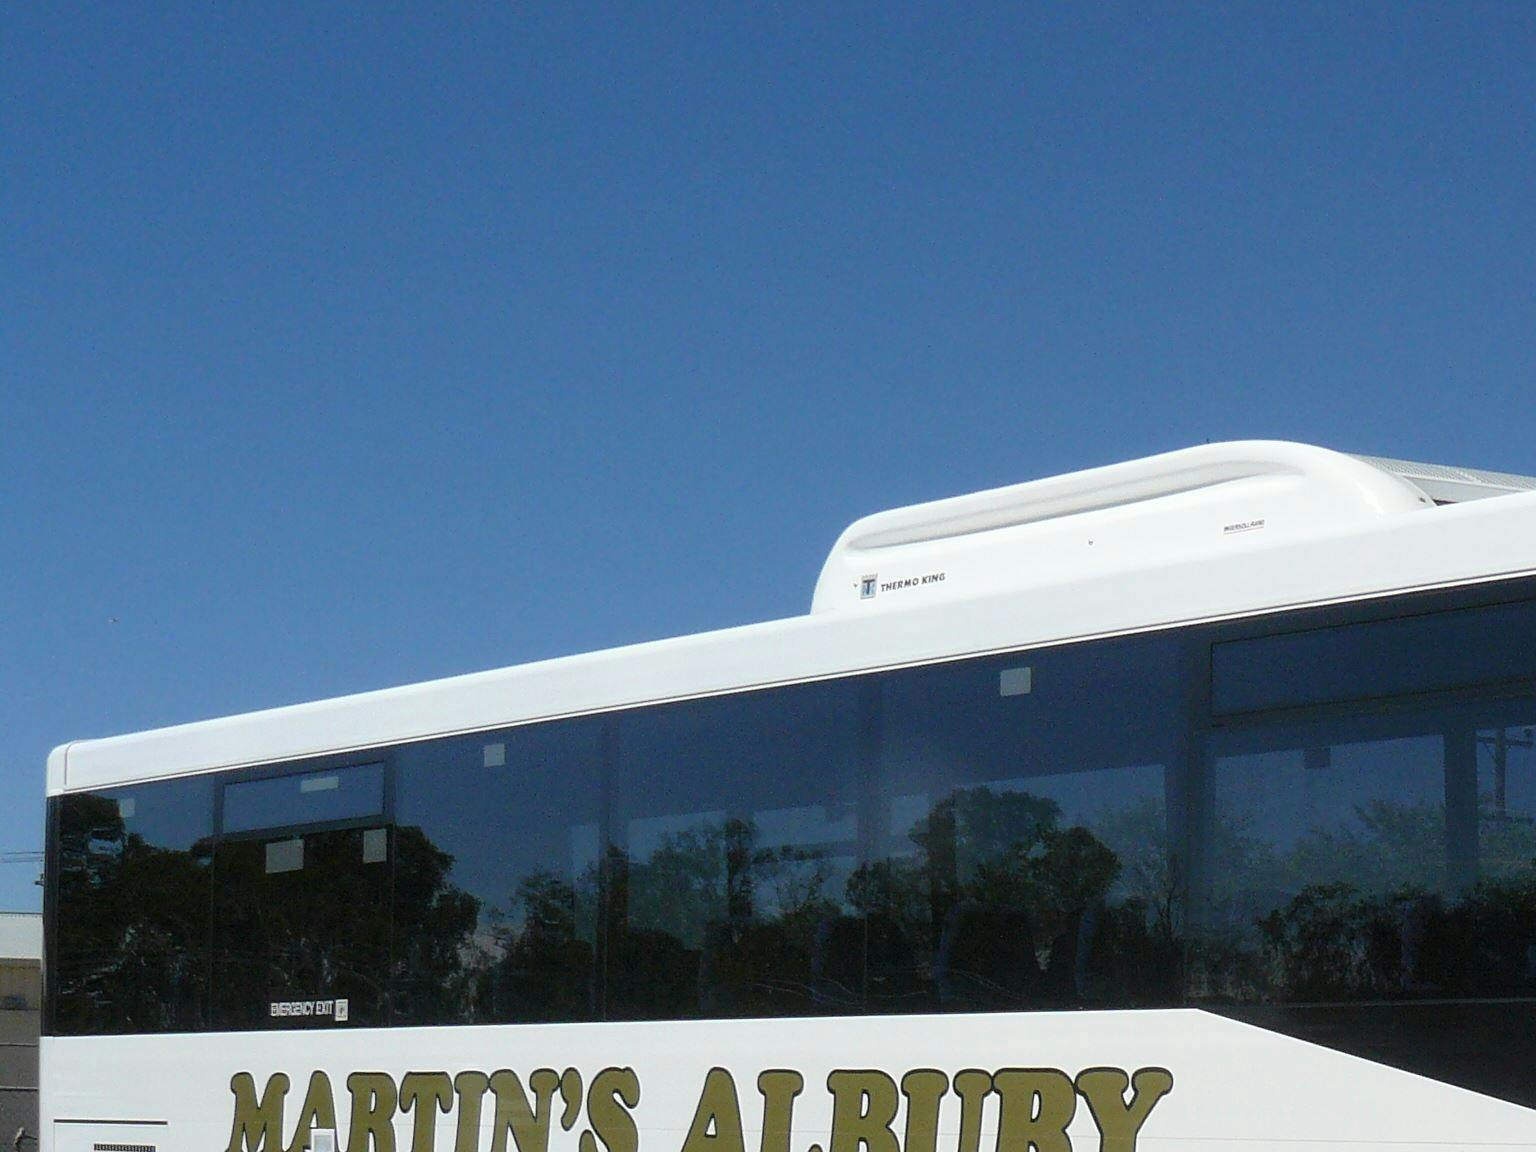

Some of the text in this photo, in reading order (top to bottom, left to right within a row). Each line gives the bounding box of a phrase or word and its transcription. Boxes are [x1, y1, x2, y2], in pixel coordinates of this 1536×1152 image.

[881, 573, 946, 592] THERMO KING
[270, 1000, 334, 1017] EMERGENCY EXIT
